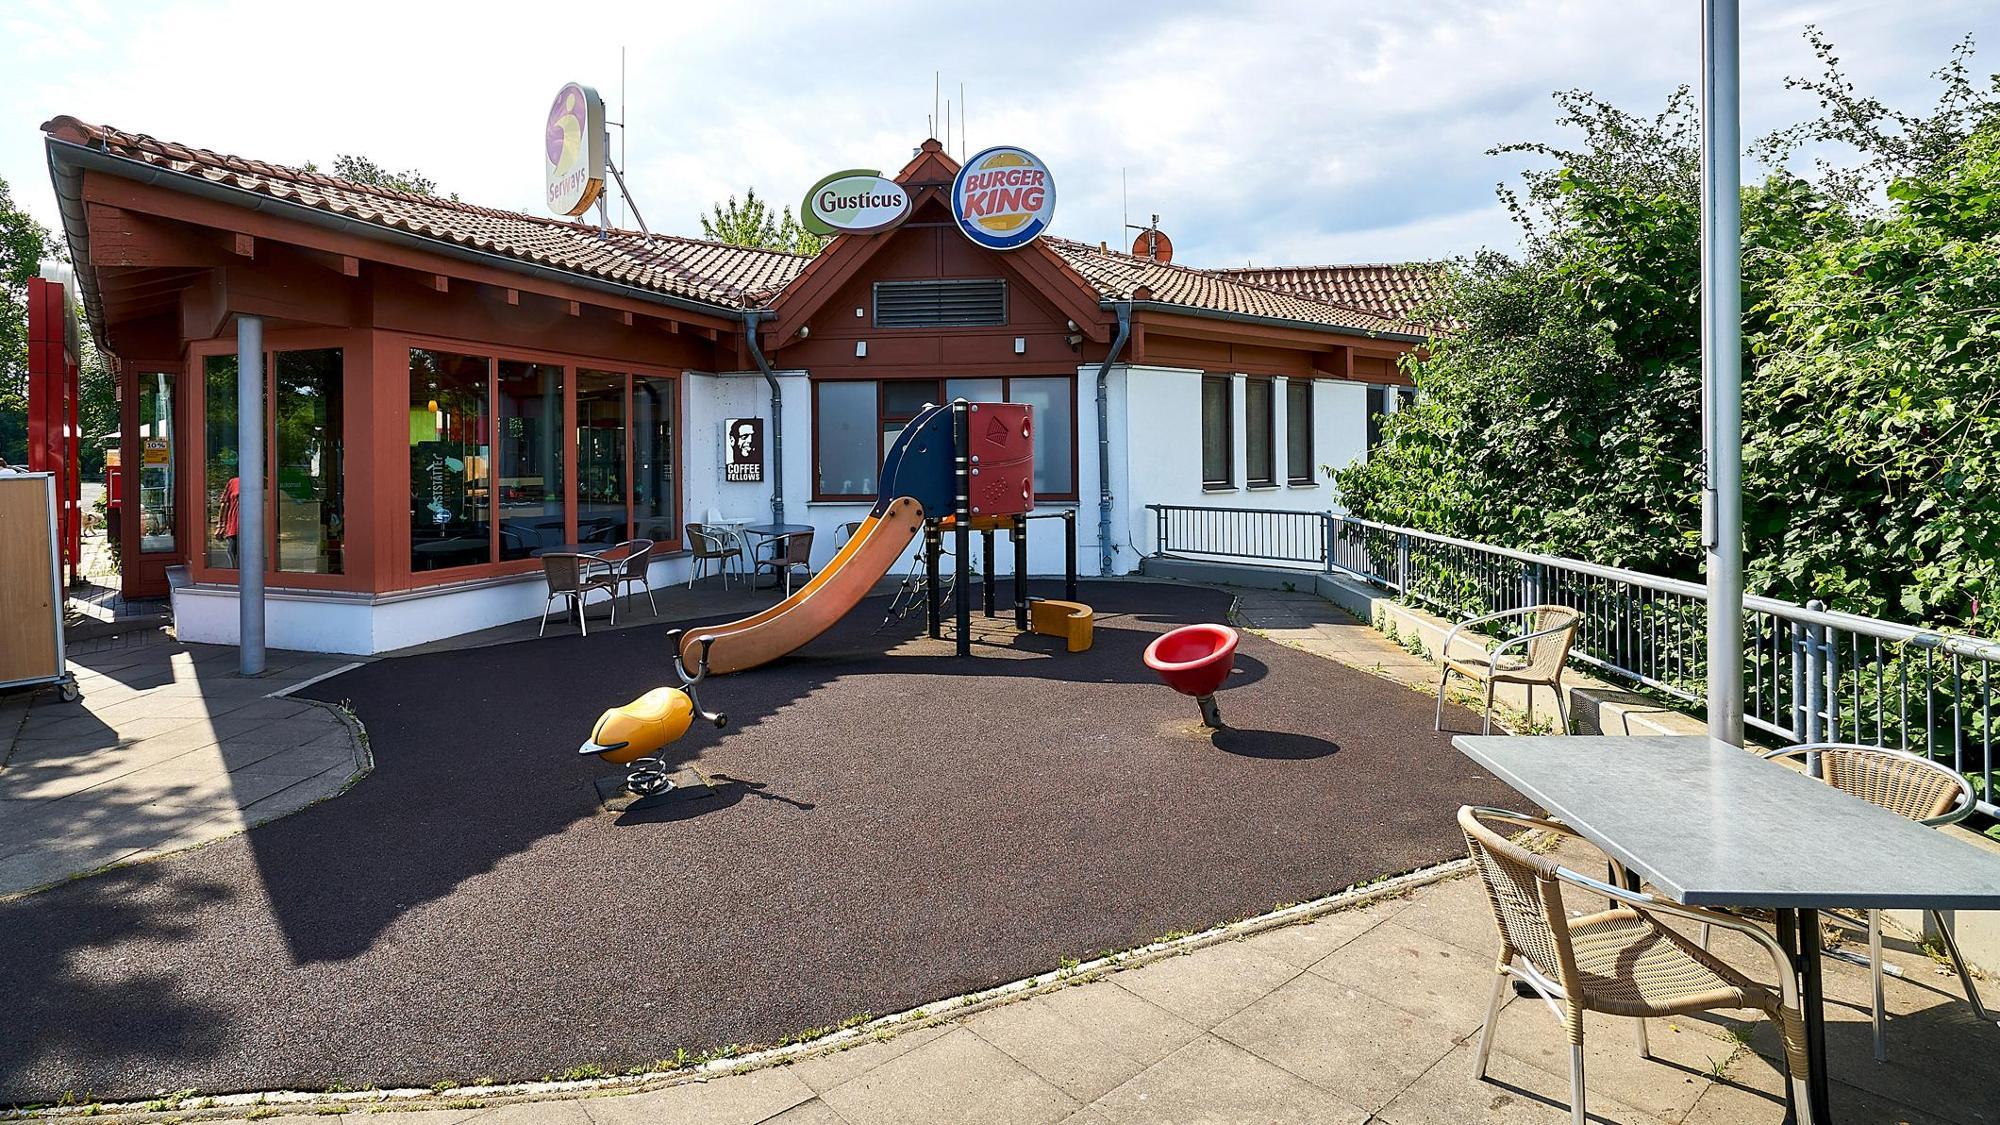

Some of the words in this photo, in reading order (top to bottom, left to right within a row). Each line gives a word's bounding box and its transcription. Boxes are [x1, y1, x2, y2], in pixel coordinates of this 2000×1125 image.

[549, 167, 586, 202] Serways
[964, 168, 1046, 194] BURGER
[819, 191, 902, 213] Gusticus
[961, 187, 1046, 220] KING
[727, 463, 760, 474] COFFEE
[727, 473, 761, 481] FELLOWS
